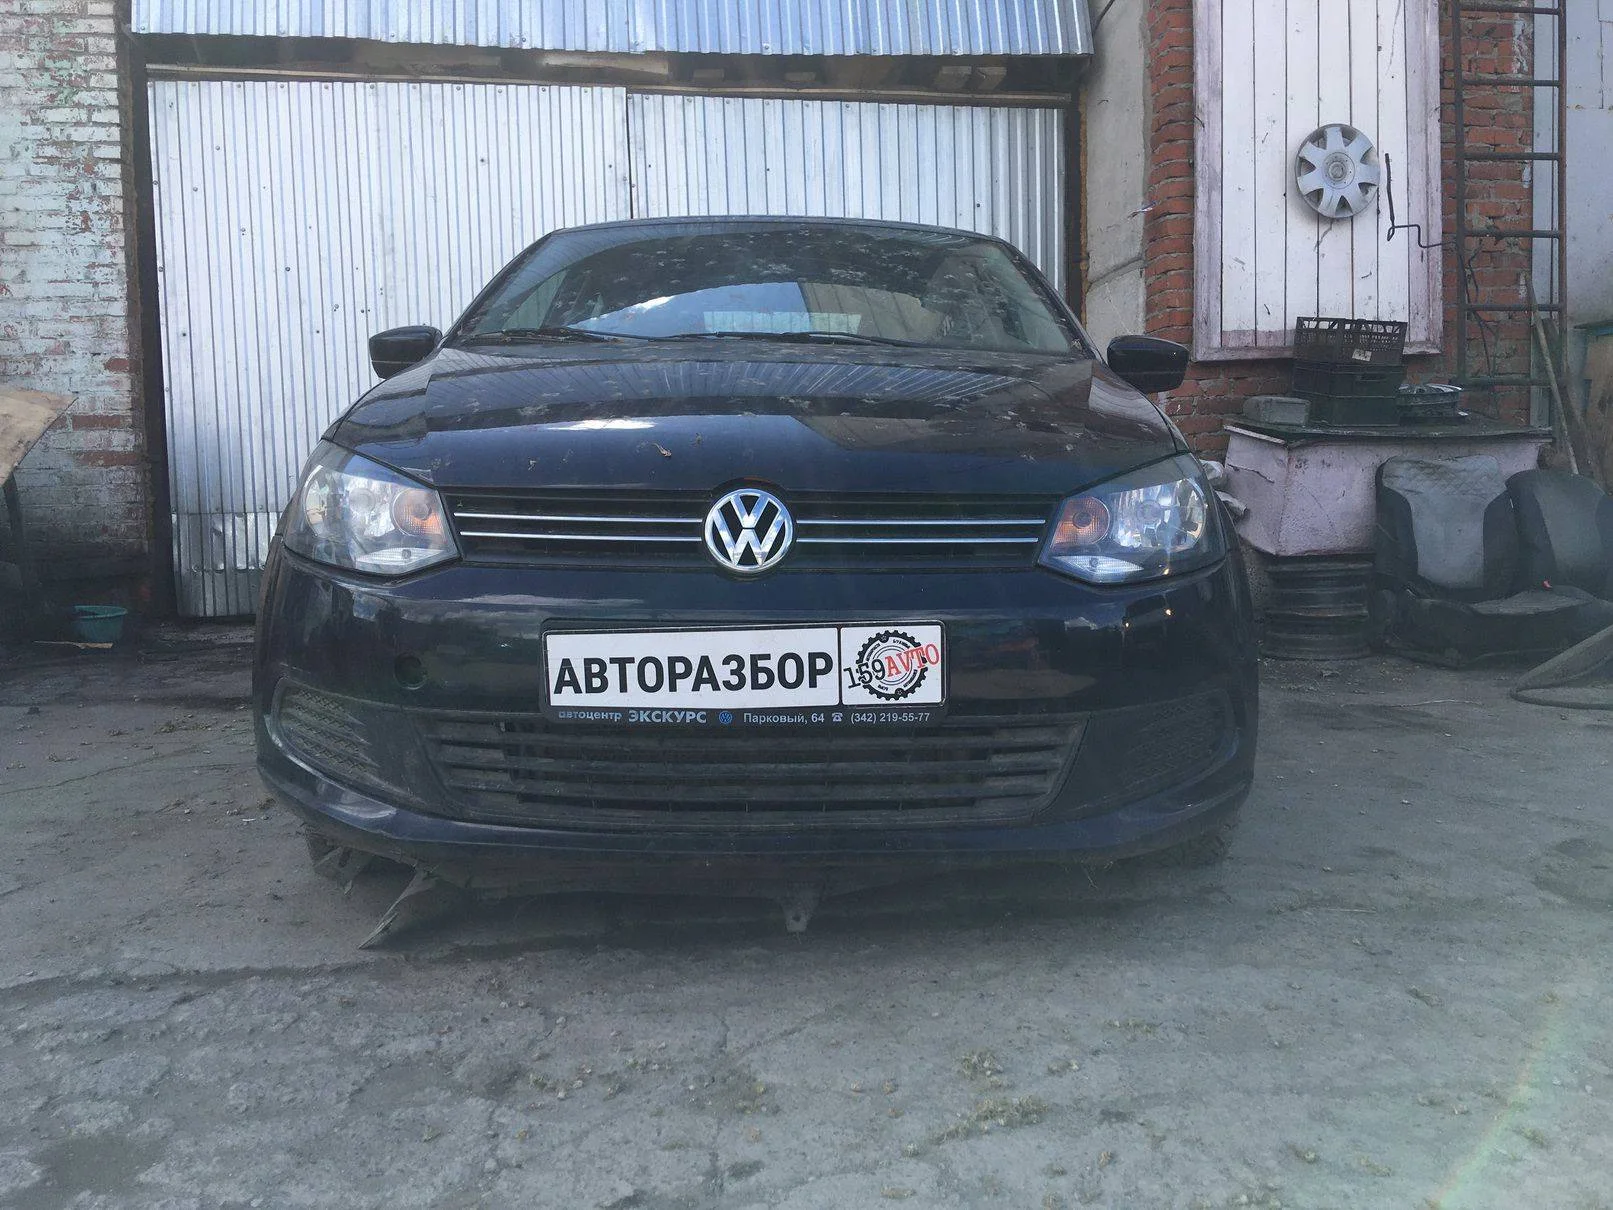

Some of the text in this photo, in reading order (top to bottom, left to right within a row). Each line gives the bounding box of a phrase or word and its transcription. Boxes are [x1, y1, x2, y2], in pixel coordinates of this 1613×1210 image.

[708, 489, 790, 571] VW
[553, 652, 834, 694] АВТОРАЗБОР
[558, 710, 623, 722] автоцентр
[628, 710, 707, 723] ЭКСКУРС
[743, 712, 808, 724] Парковый,
[811, 713, 825, 723] 64
[850, 712, 877, 723] (342)
[879, 712, 930, 722] 219-55-77
